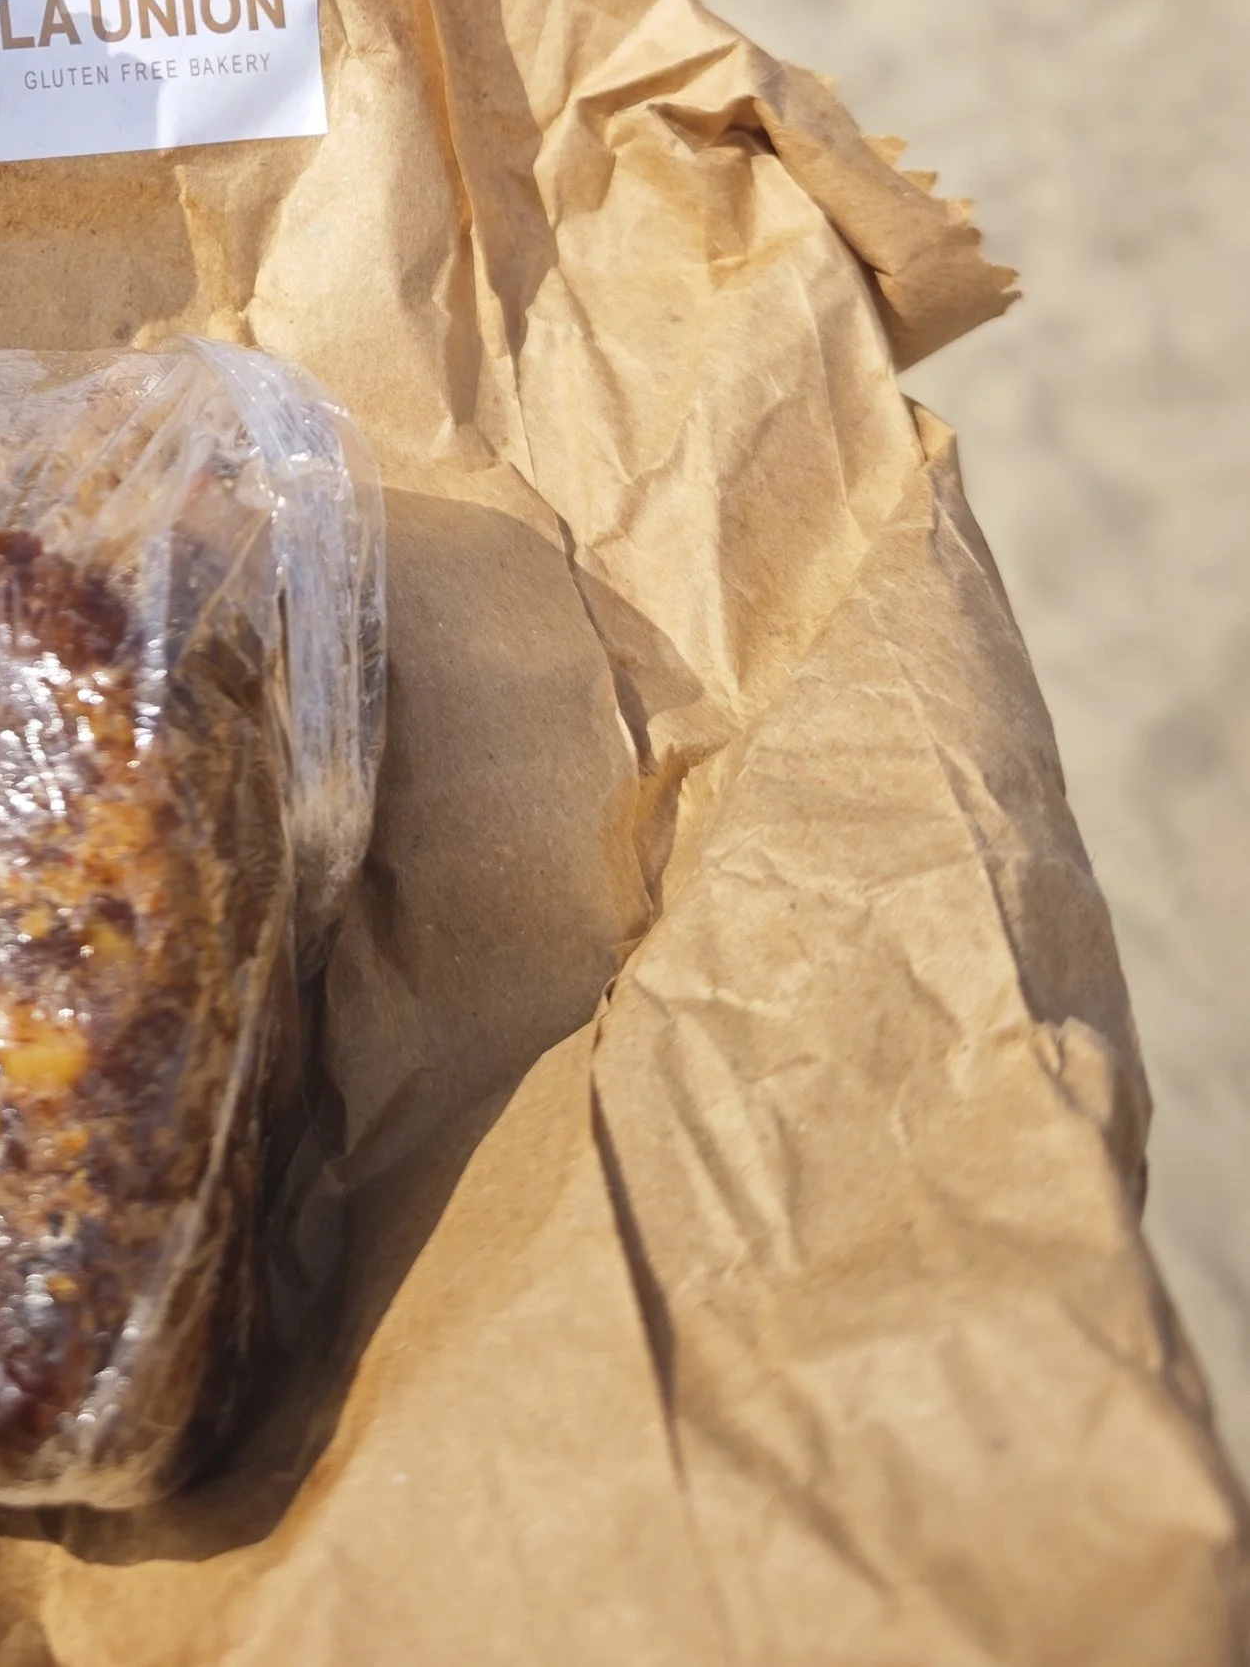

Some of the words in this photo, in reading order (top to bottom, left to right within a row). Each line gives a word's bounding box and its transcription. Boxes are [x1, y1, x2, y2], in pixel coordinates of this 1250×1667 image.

[23, 65, 110, 91] GLUTEN
[120, 59, 178, 84] FREE
[189, 52, 272, 79] BAKERY
